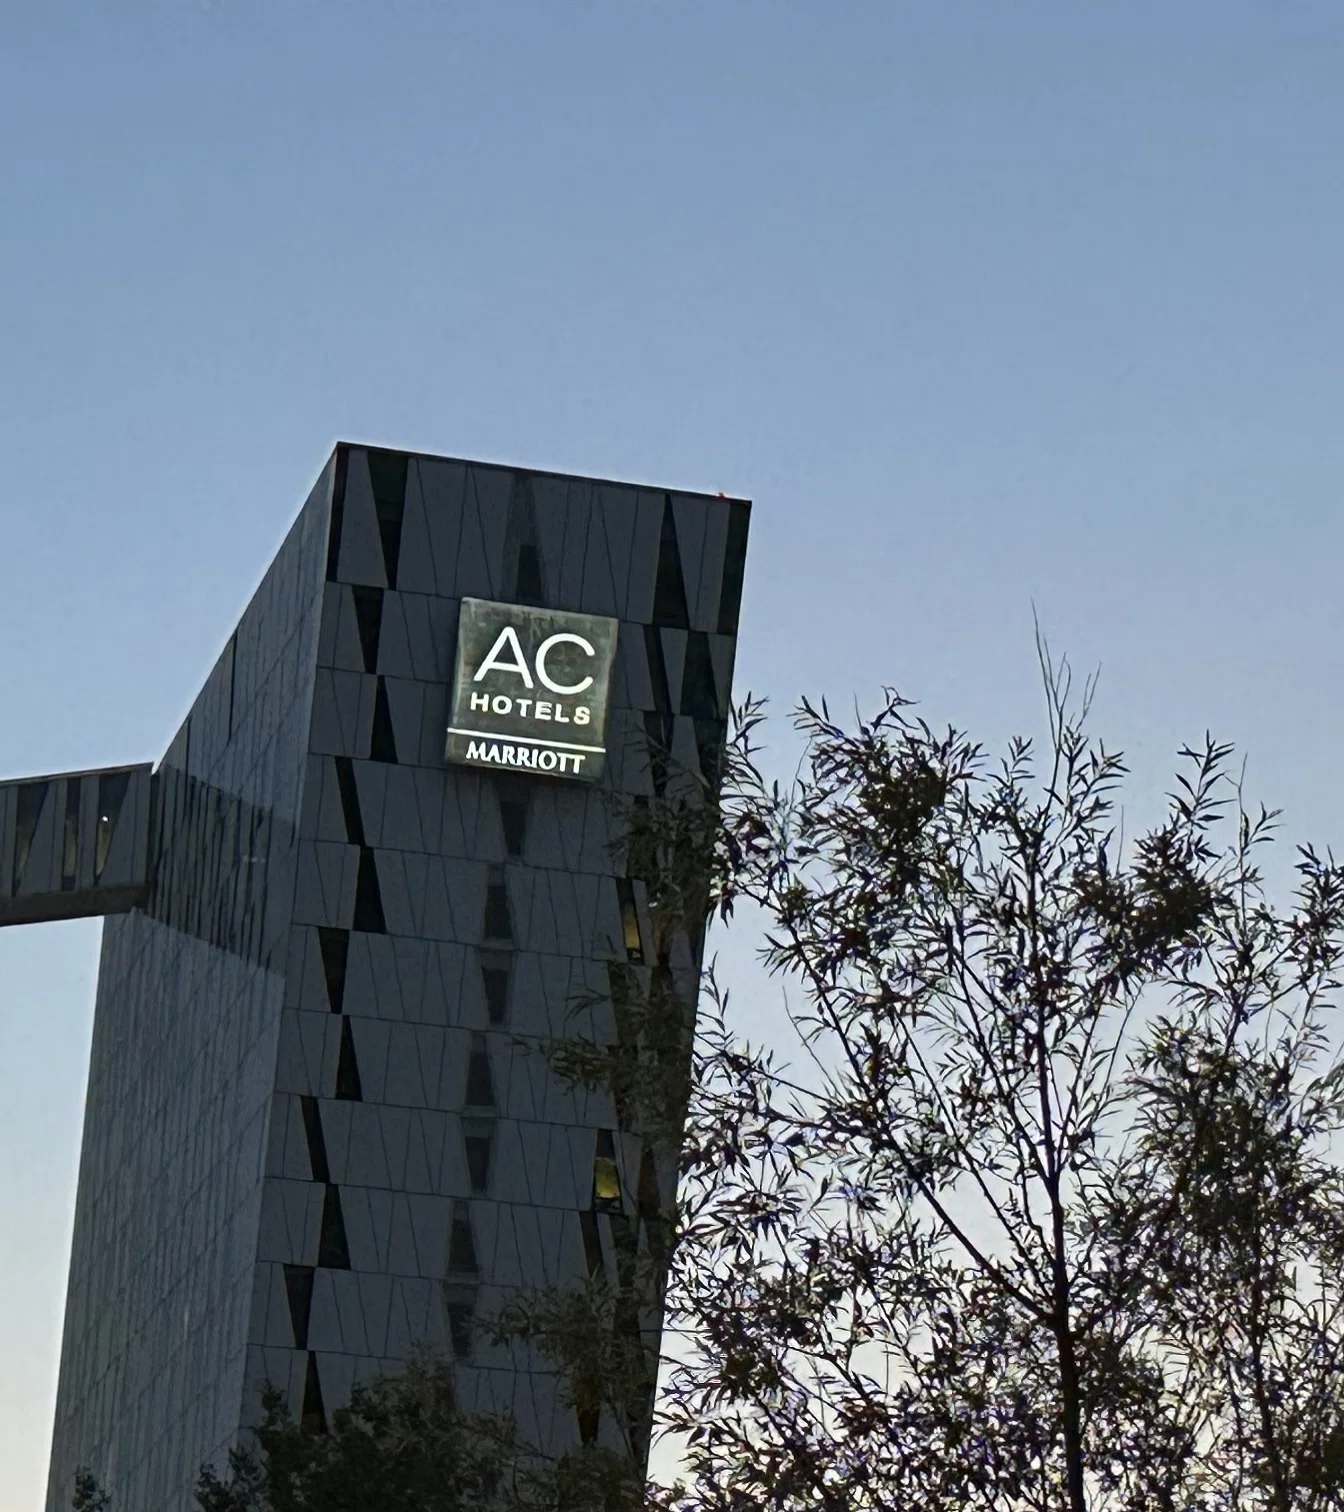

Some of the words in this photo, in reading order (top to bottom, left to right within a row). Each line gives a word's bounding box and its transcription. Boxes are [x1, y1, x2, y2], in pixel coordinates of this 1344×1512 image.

[473, 626, 595, 695] AC
[470, 691, 591, 725] HOTELS
[465, 740, 586, 774] MARRIOTT
